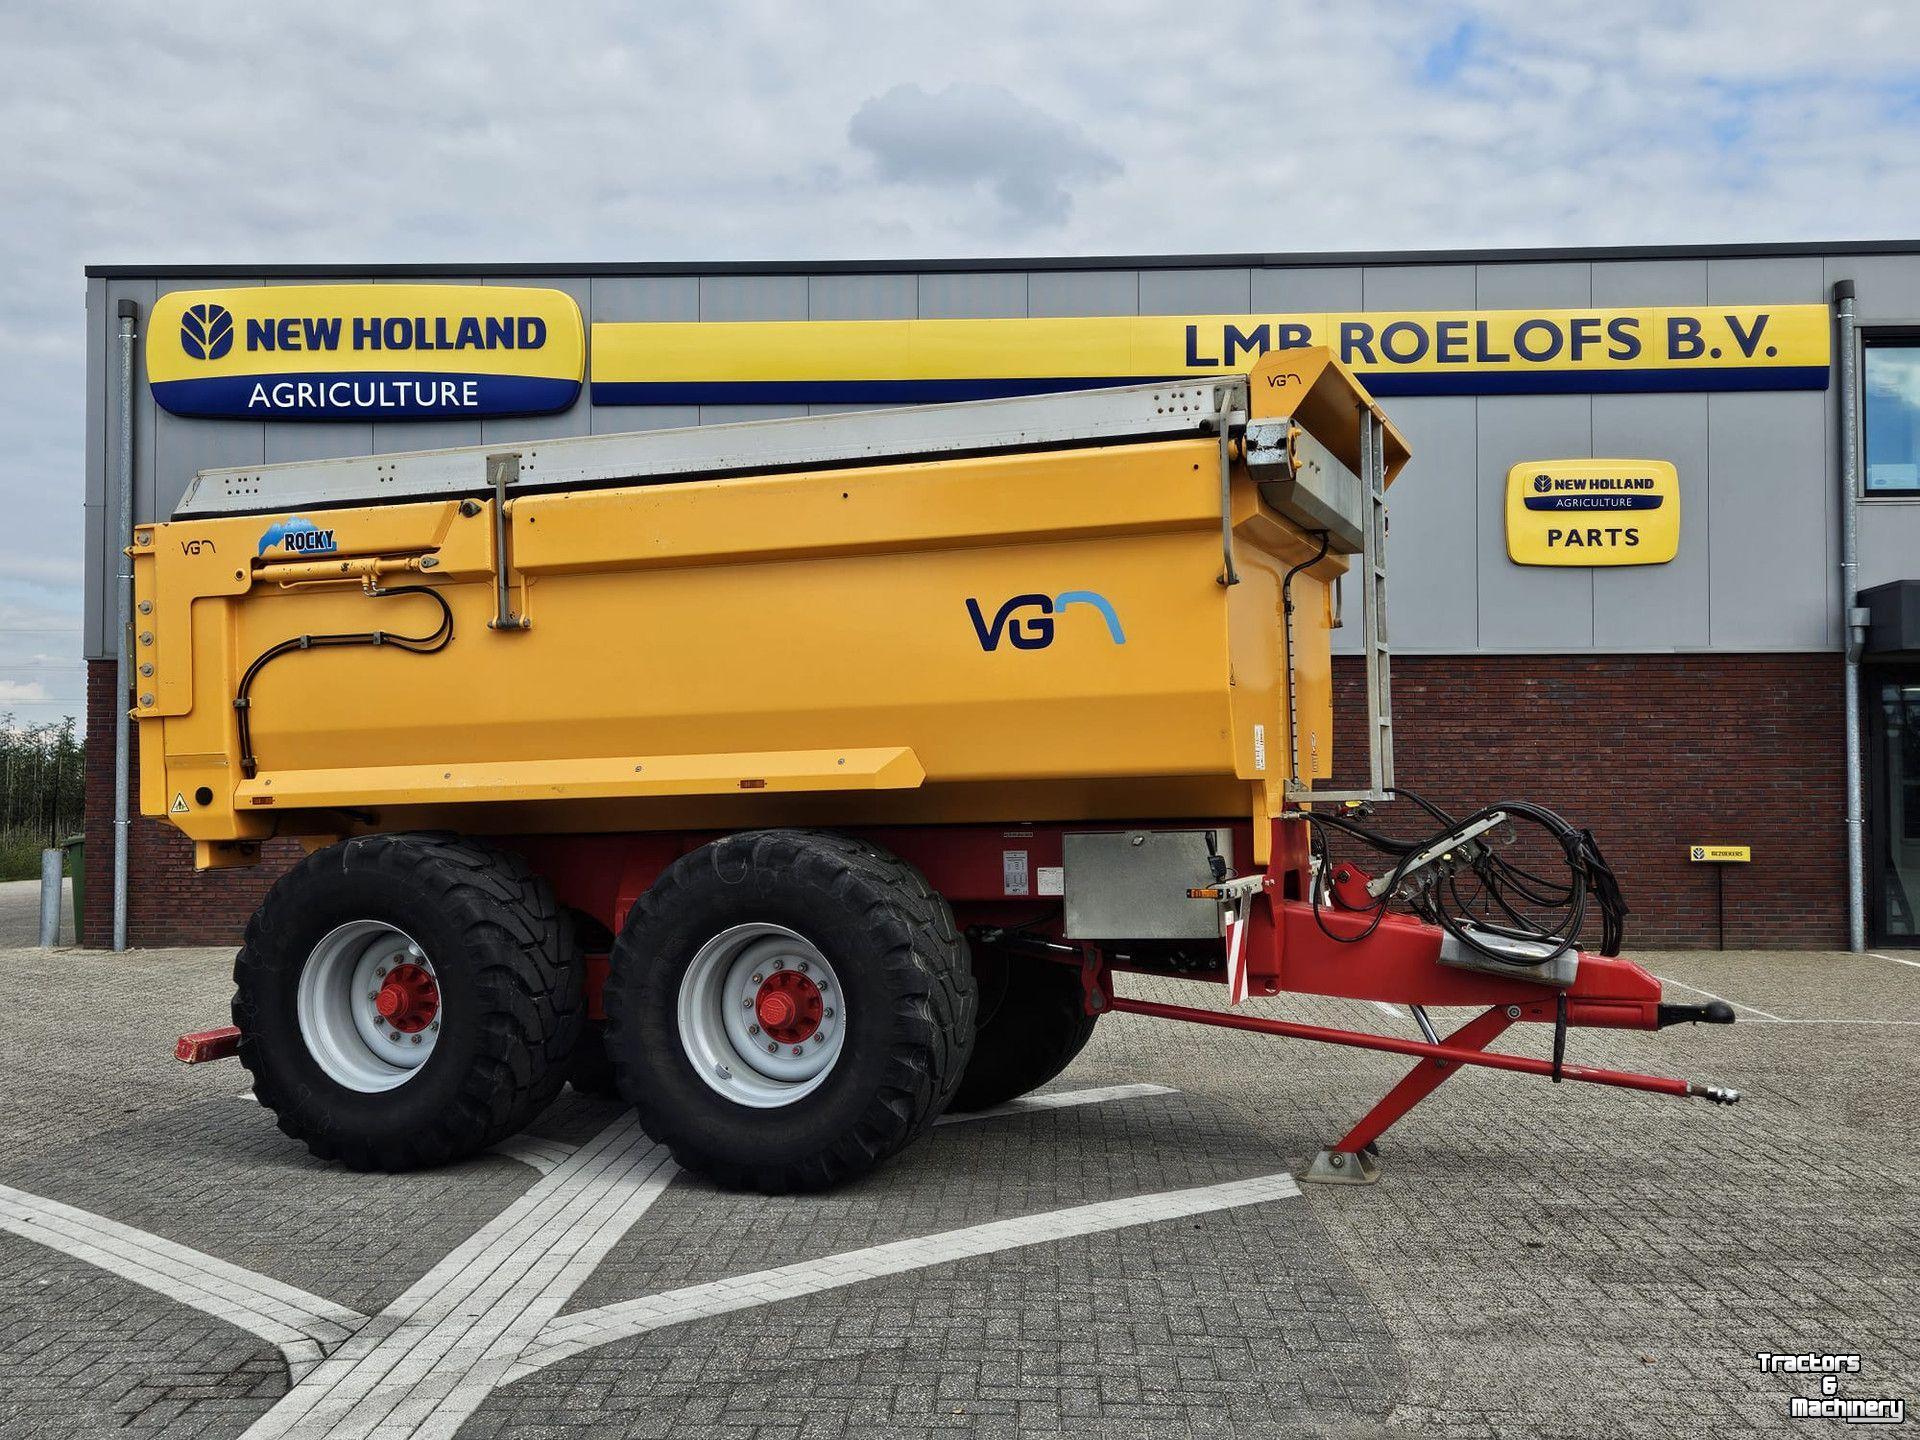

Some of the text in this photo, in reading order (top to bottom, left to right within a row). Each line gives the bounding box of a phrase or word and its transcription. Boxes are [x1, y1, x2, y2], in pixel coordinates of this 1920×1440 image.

[247, 316, 547, 351] NEW HOLLAND
[1340, 316, 1642, 365] ROELOFS
[1667, 314, 1779, 361] B.V.
[248, 381, 479, 408] AGRICULTURE
[1554, 478, 1655, 490] NEW HOLLAND
[1555, 497, 1633, 508] AGRICULTURE
[284, 529, 335, 552] ROCKY
[1547, 528, 1640, 547] PARTS
